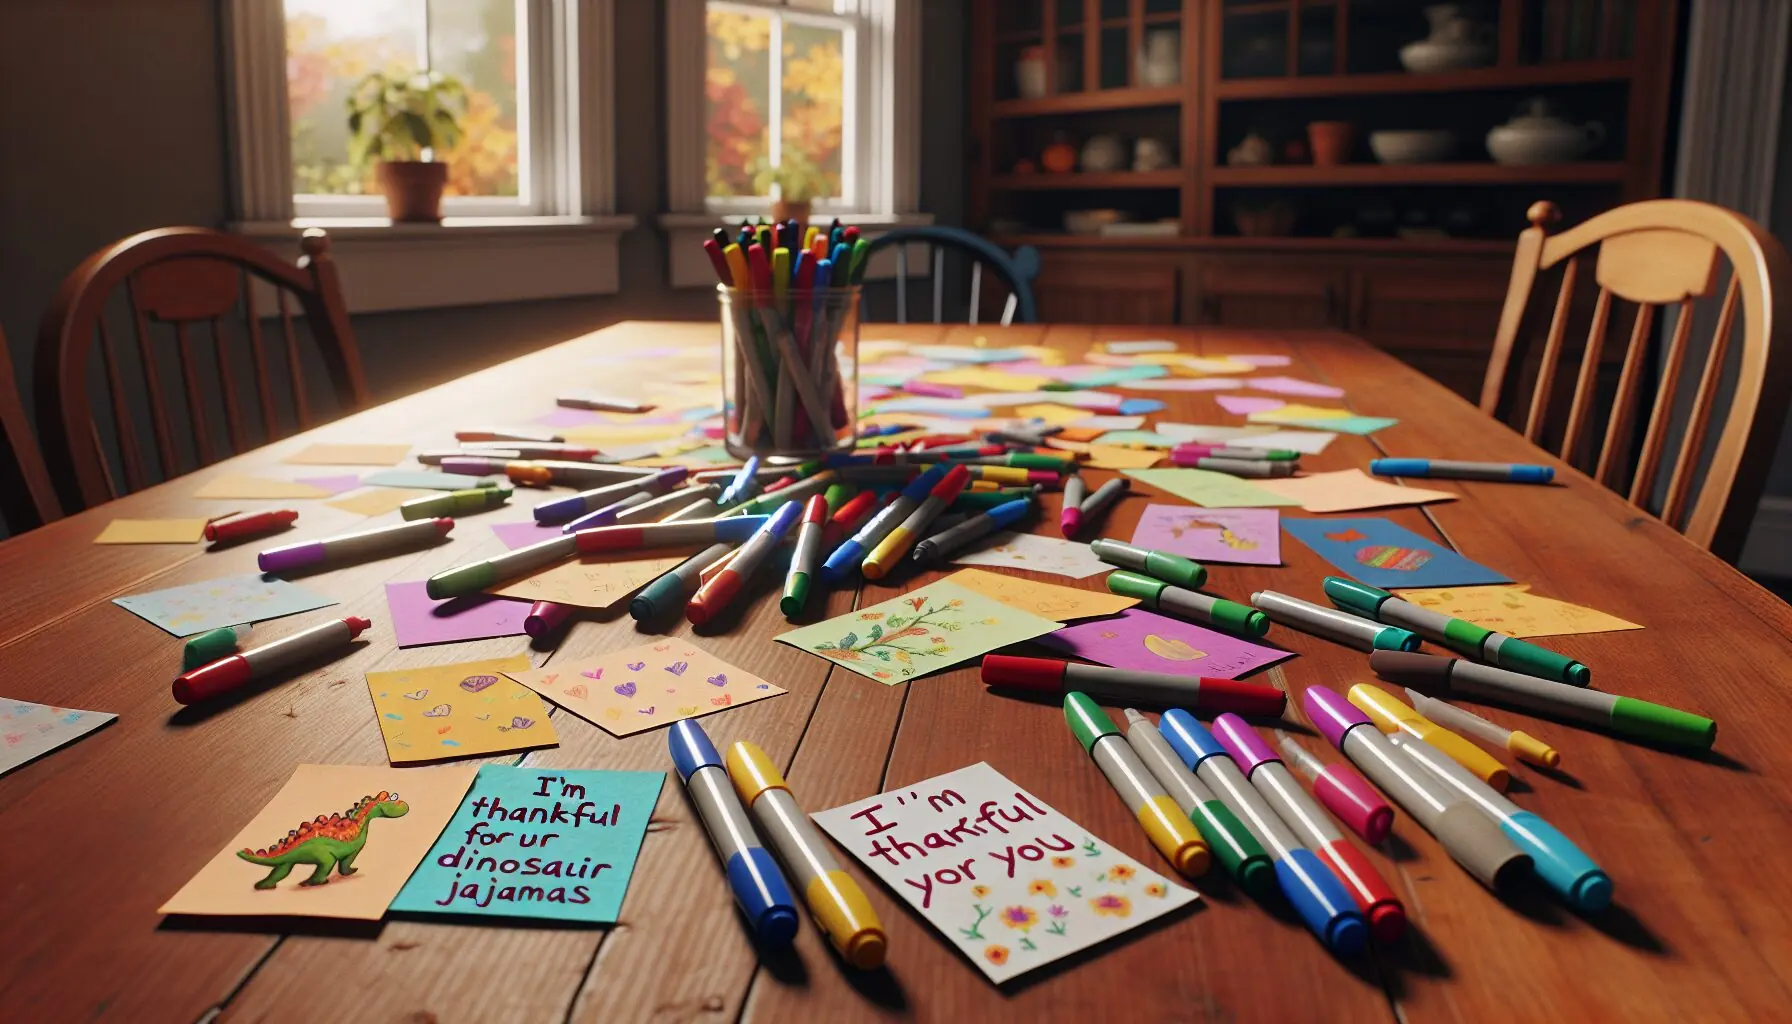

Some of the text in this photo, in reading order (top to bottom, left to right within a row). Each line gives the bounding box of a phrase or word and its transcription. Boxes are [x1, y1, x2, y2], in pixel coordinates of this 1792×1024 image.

[532, 776, 586, 800] I'm
[471, 796, 621, 827] thankful
[465, 821, 560, 848] for ur
[904, 833, 1075, 909] yor you
[435, 872, 591, 908] jajamas
